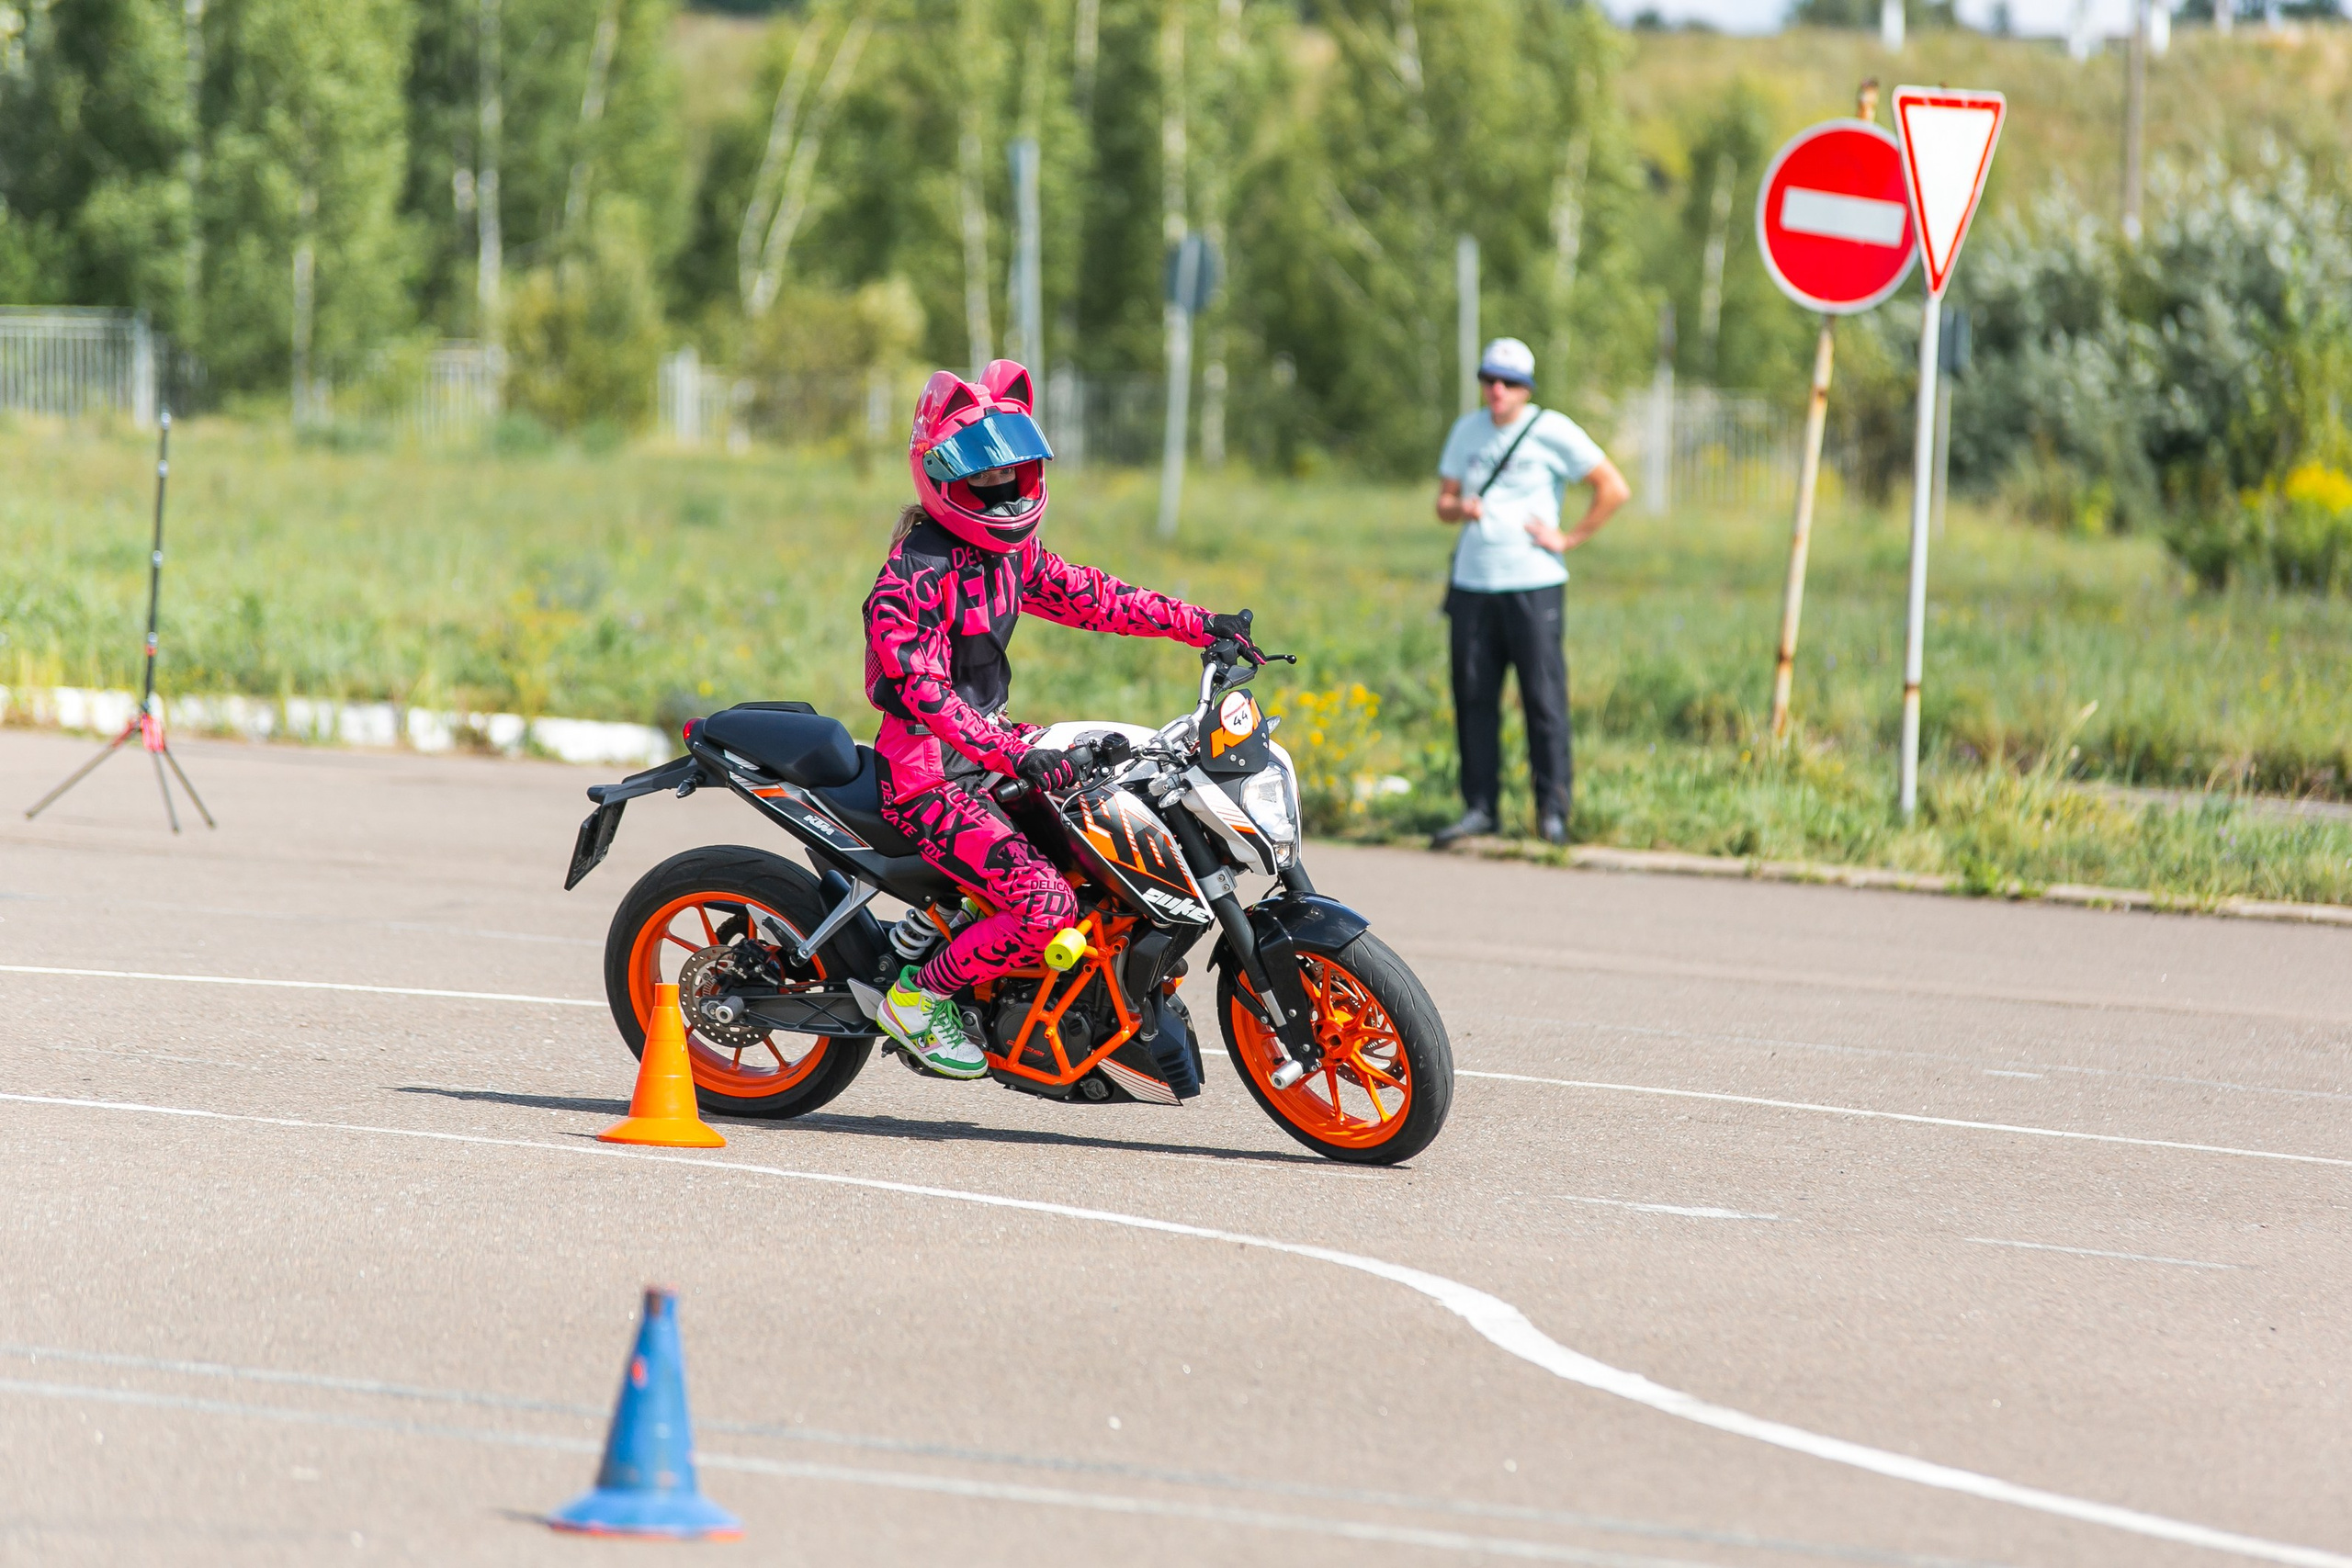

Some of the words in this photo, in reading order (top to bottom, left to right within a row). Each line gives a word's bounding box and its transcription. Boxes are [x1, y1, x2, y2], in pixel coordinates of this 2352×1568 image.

[1233, 710, 1249, 726] 44
[803, 814, 835, 836] KTM
[917, 837, 946, 862] FOX
[1030, 880, 1073, 895] DELICA
